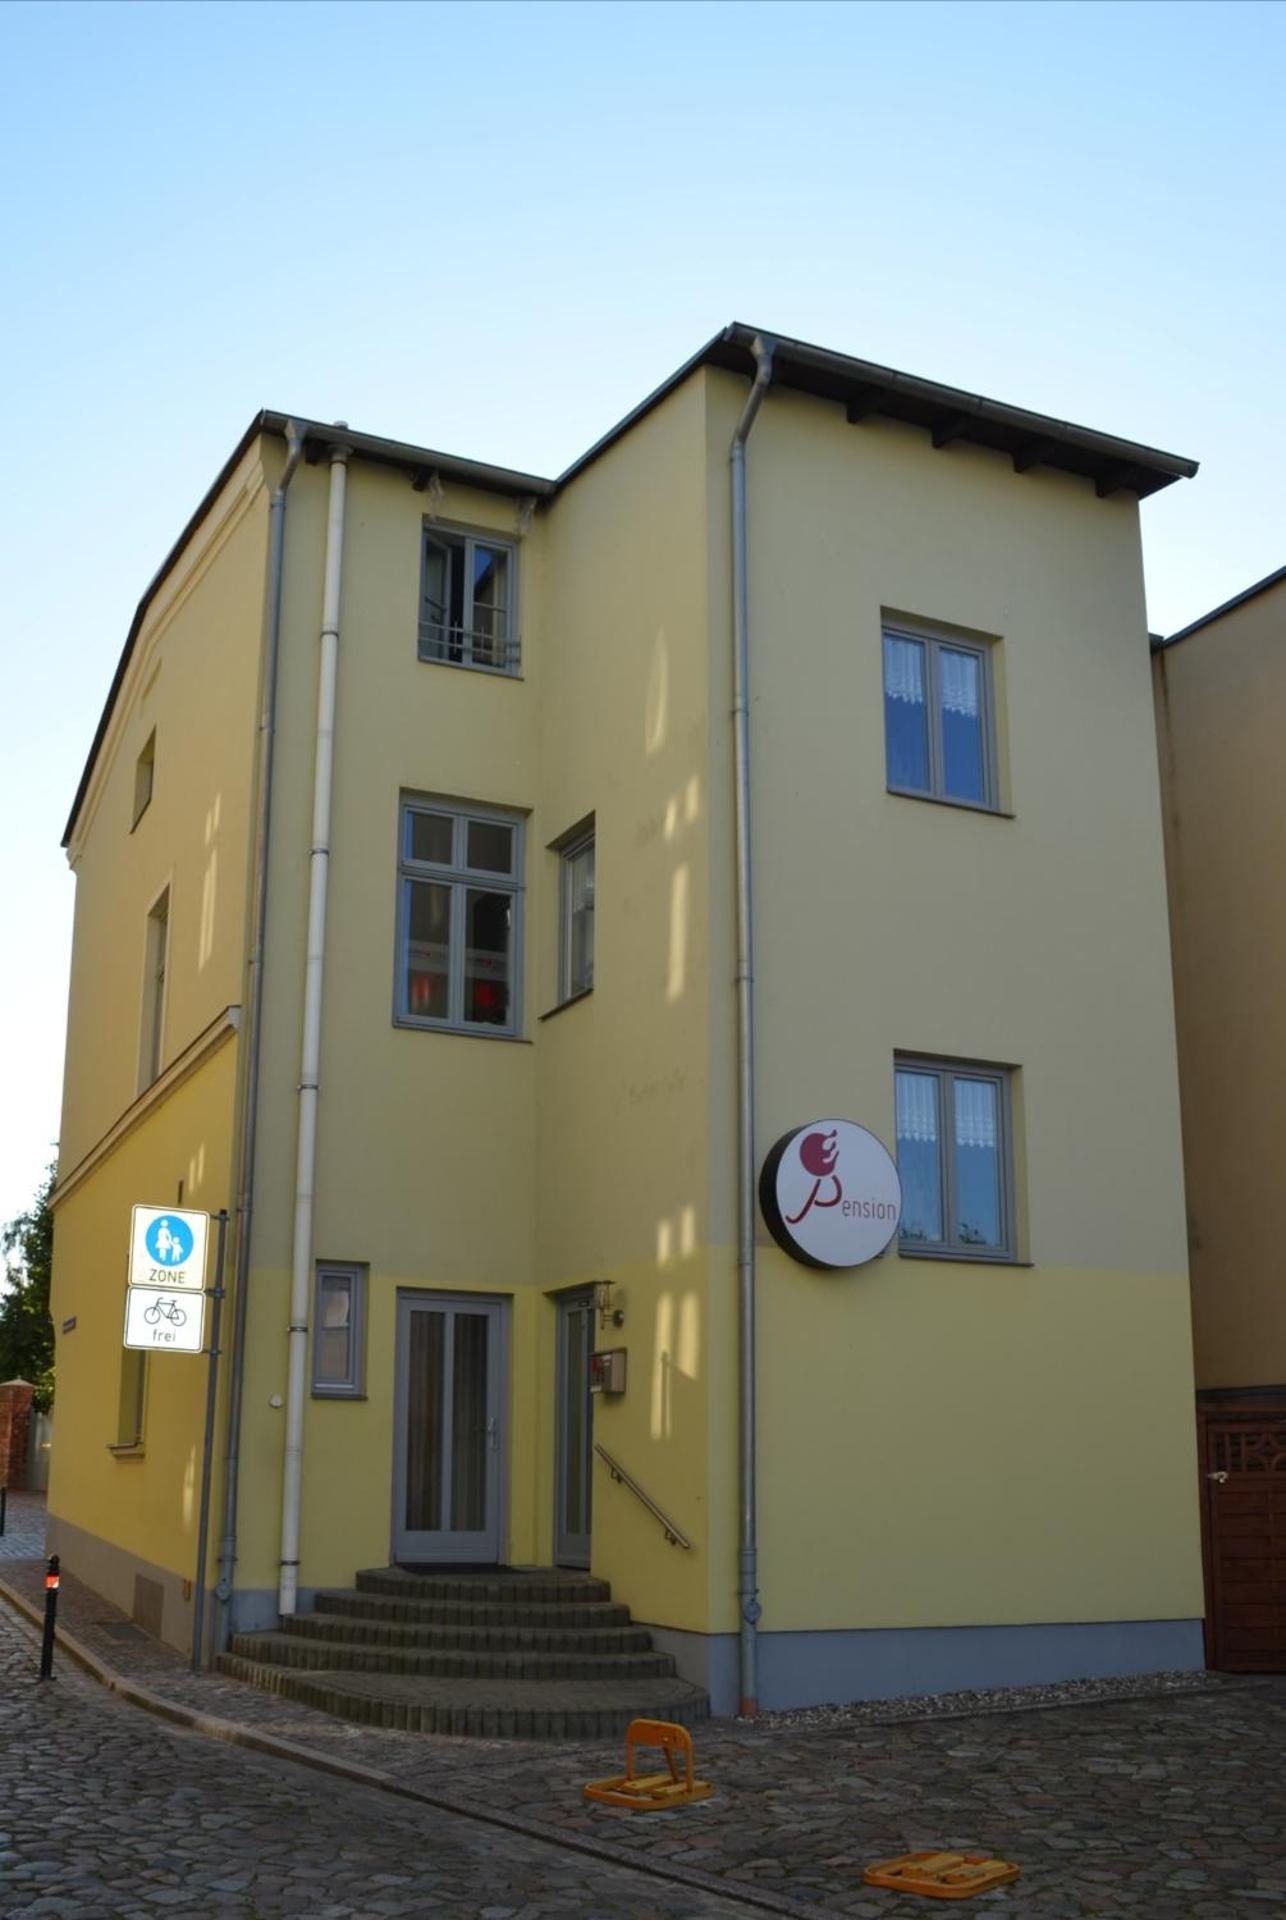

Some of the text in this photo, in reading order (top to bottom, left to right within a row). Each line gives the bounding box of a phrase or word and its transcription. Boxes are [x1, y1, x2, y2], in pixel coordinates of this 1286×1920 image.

[785, 1174, 897, 1224] Pension
[149, 1268, 186, 1284] ZONE
[153, 1329, 176, 1342] frei
